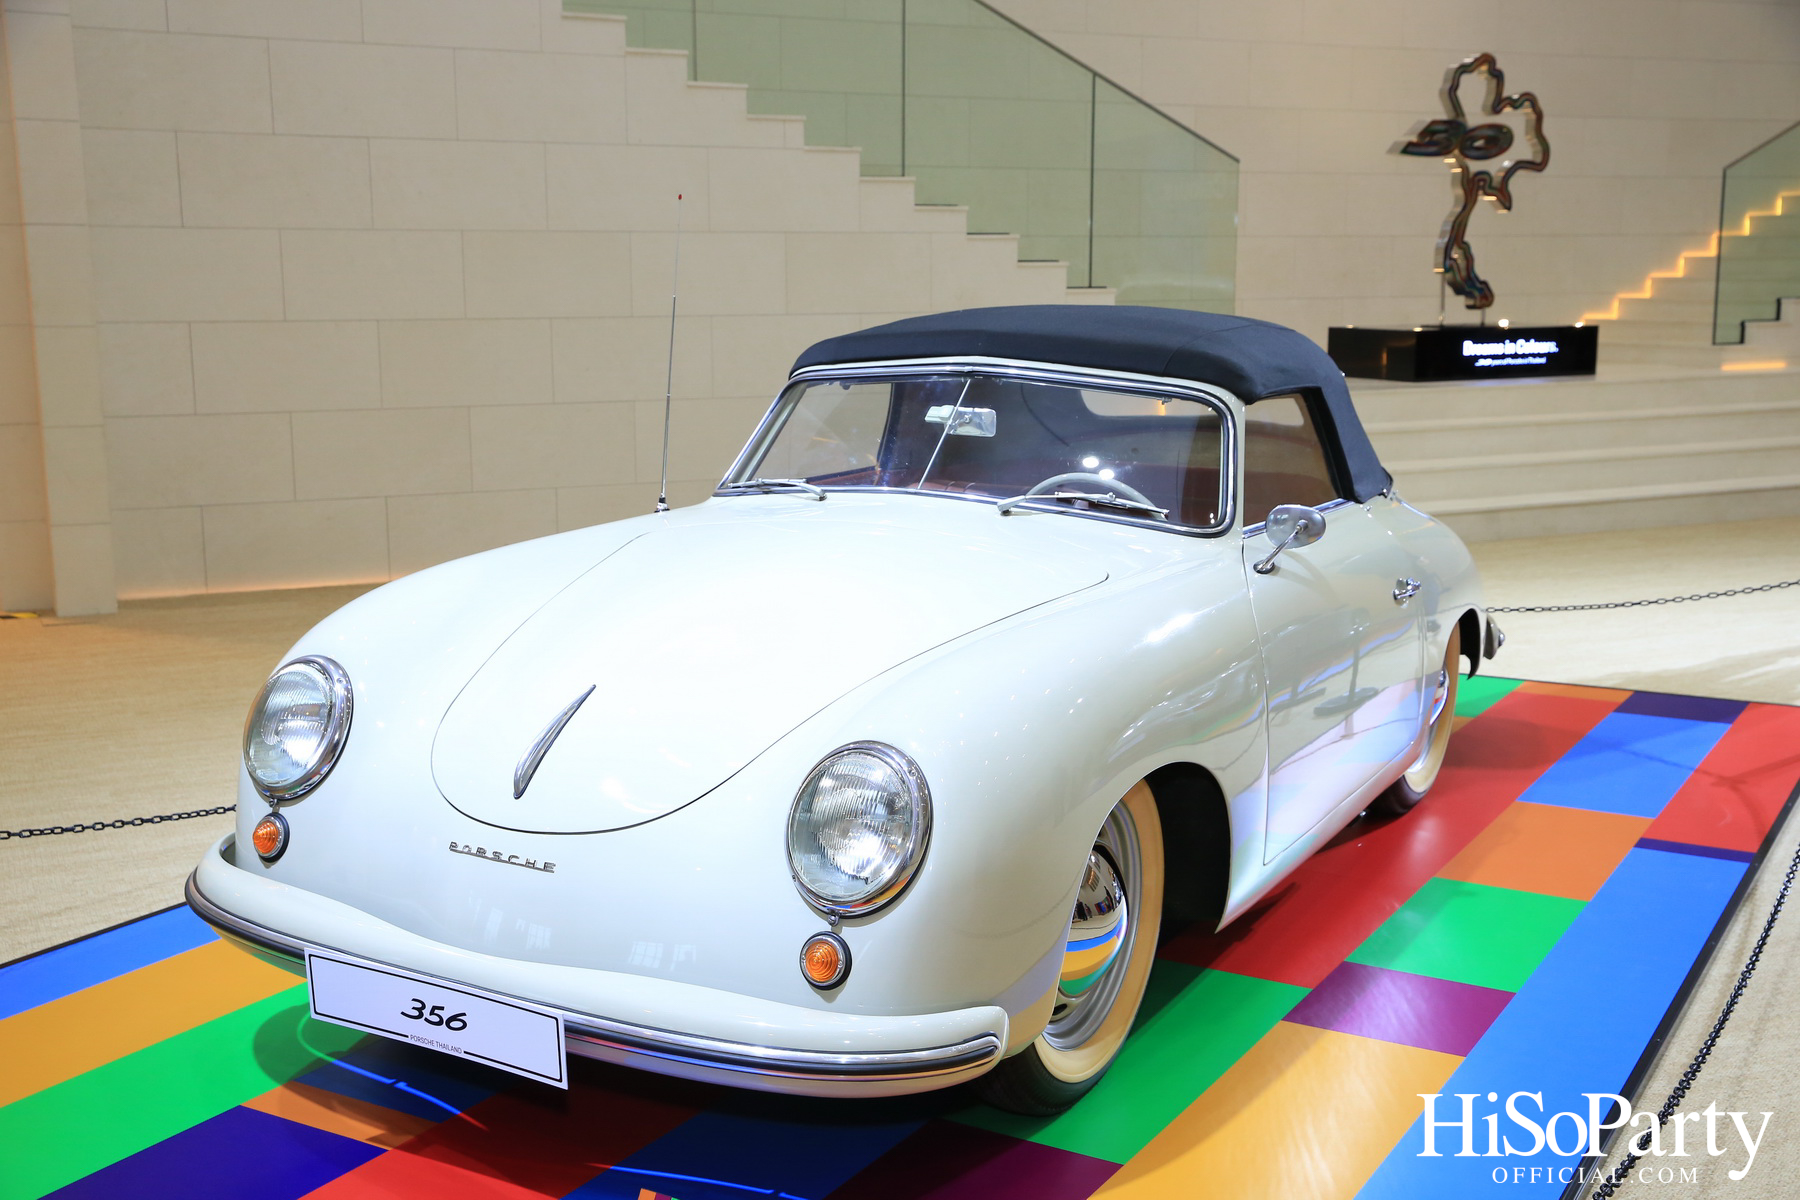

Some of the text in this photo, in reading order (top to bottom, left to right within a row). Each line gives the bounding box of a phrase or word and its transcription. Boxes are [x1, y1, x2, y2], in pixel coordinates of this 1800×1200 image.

[449, 841, 556, 873] PORSCHE
[400, 998, 468, 1031] 356
[410, 1034, 462, 1054] PORSCHE THAILAND
